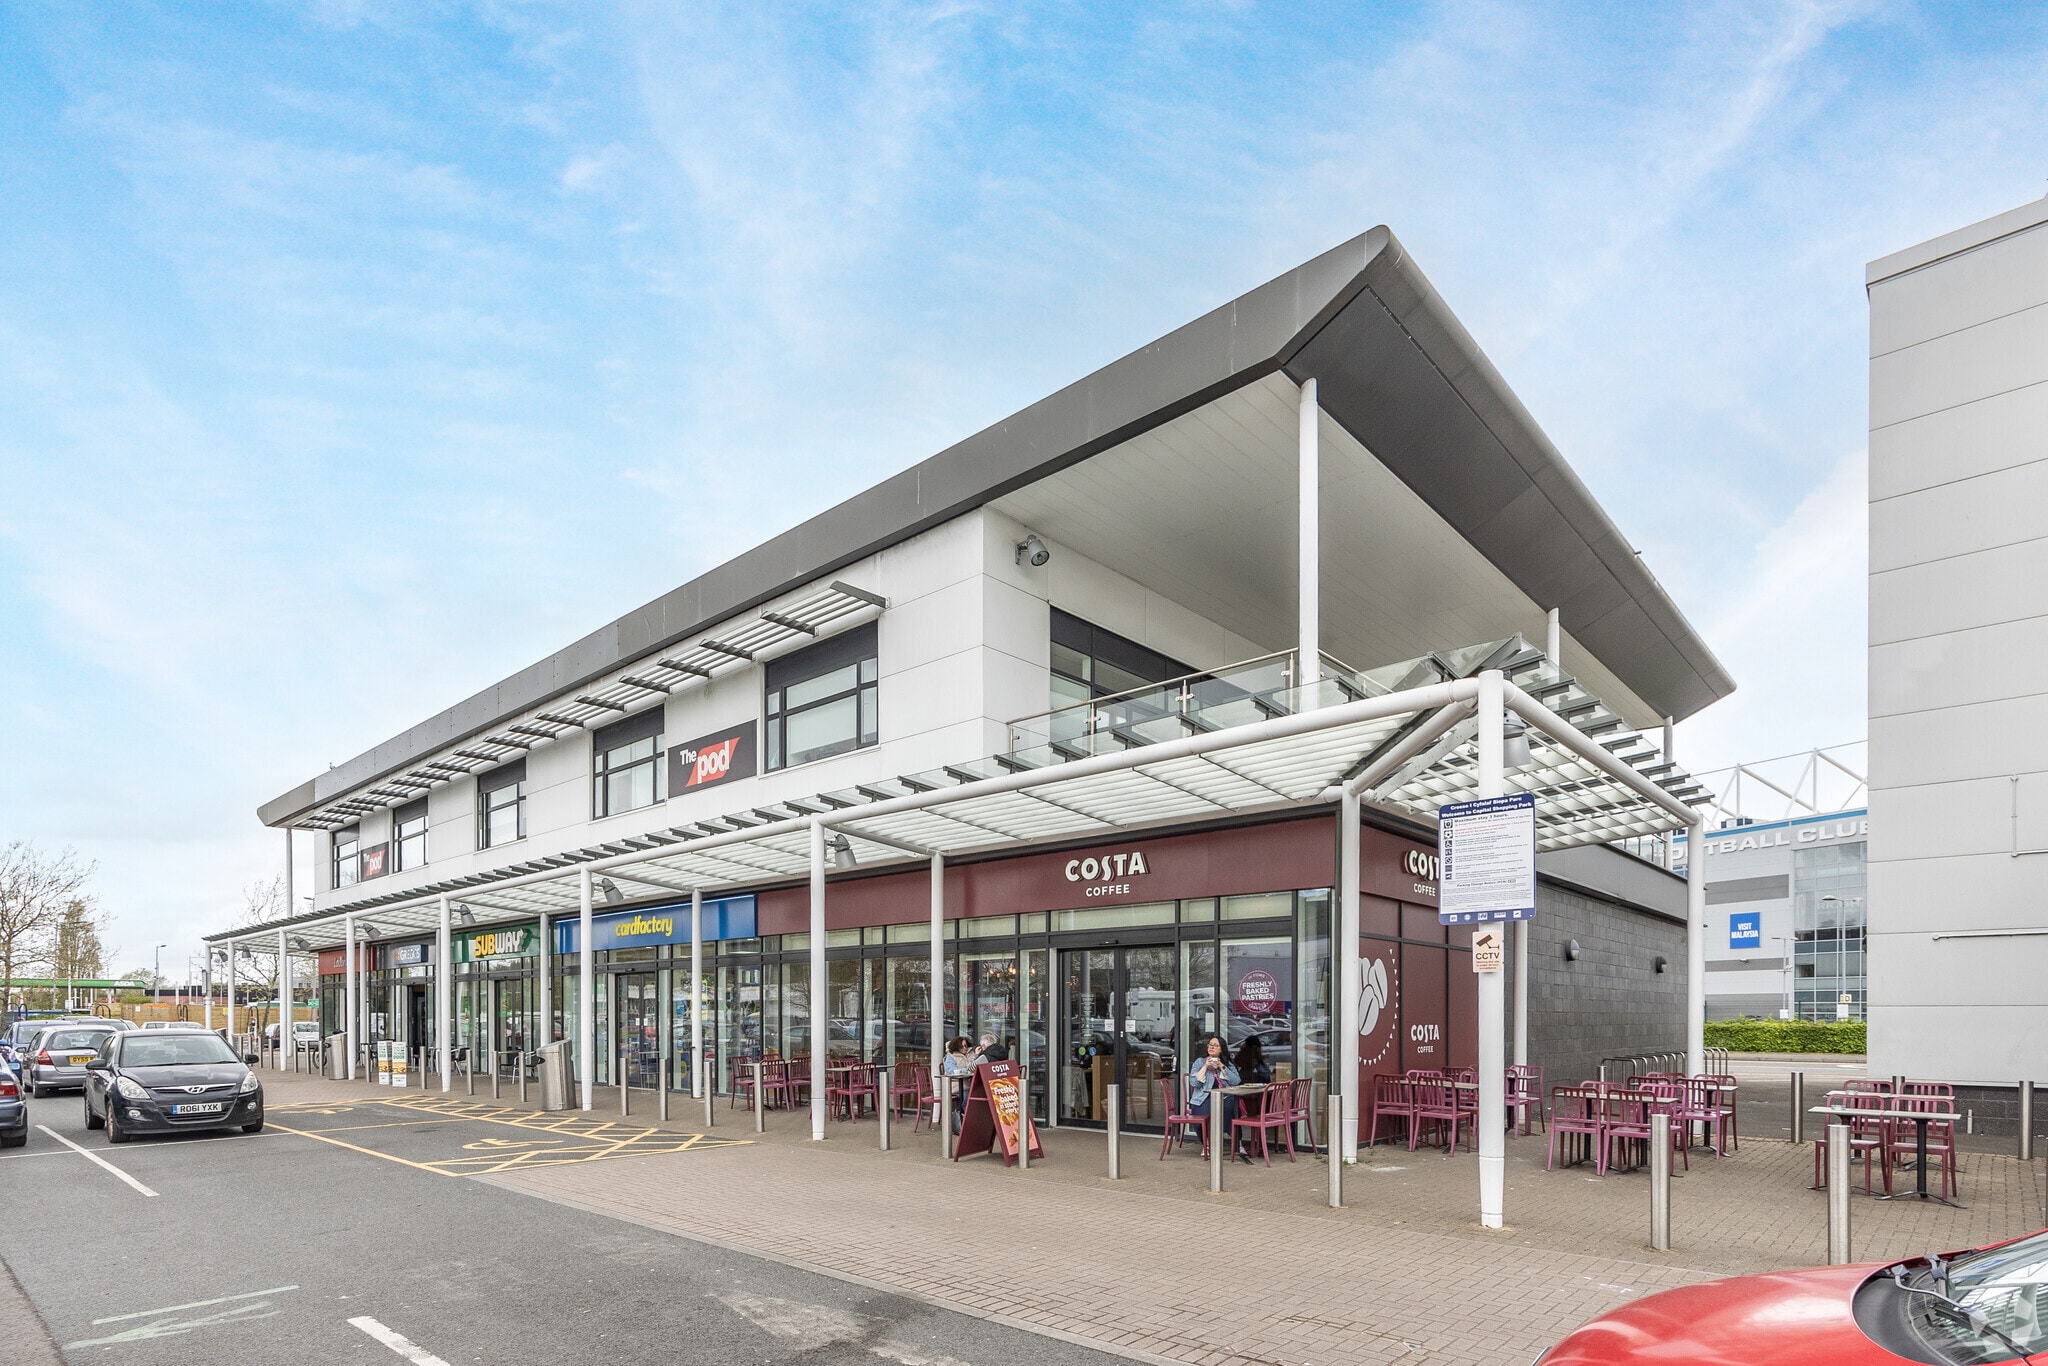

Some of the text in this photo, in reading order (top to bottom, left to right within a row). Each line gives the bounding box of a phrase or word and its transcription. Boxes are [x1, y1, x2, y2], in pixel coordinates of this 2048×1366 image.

[680, 740, 730, 784] The pod
[1473, 800, 1492, 808] Cyfalaf
[1441, 810, 1465, 818] Welcome
[1472, 807, 1492, 815] Capital
[1492, 804, 1518, 812] Shopping
[1797, 821, 1868, 844] CLU
[1065, 851, 1147, 882] COSTA
[1405, 850, 1440, 881] COST
[1085, 884, 1130, 897] COFFEE
[1413, 883, 1436, 897] COFFEE
[615, 915, 673, 937] cardfactory
[1737, 922, 1753, 931] VISIT
[1731, 930, 1759, 939] MALAYSIA
[474, 928, 524, 958] SUBWAY
[1475, 952, 1500, 960] CCTV
[1242, 980, 1273, 990] FRESHLY
[1246, 987, 1270, 995] BAKED
[1241, 992, 1275, 1001] PASTRIES
[1410, 1024, 1440, 1043] COSTA
[1417, 1045, 1434, 1054] COFFEE
[991, 1063, 1010, 1073] COSTA
[993, 1085, 1015, 1095] Freshly
[999, 1092, 1019, 1103] baked
[180, 1103, 218, 1113] RO61 YXK
